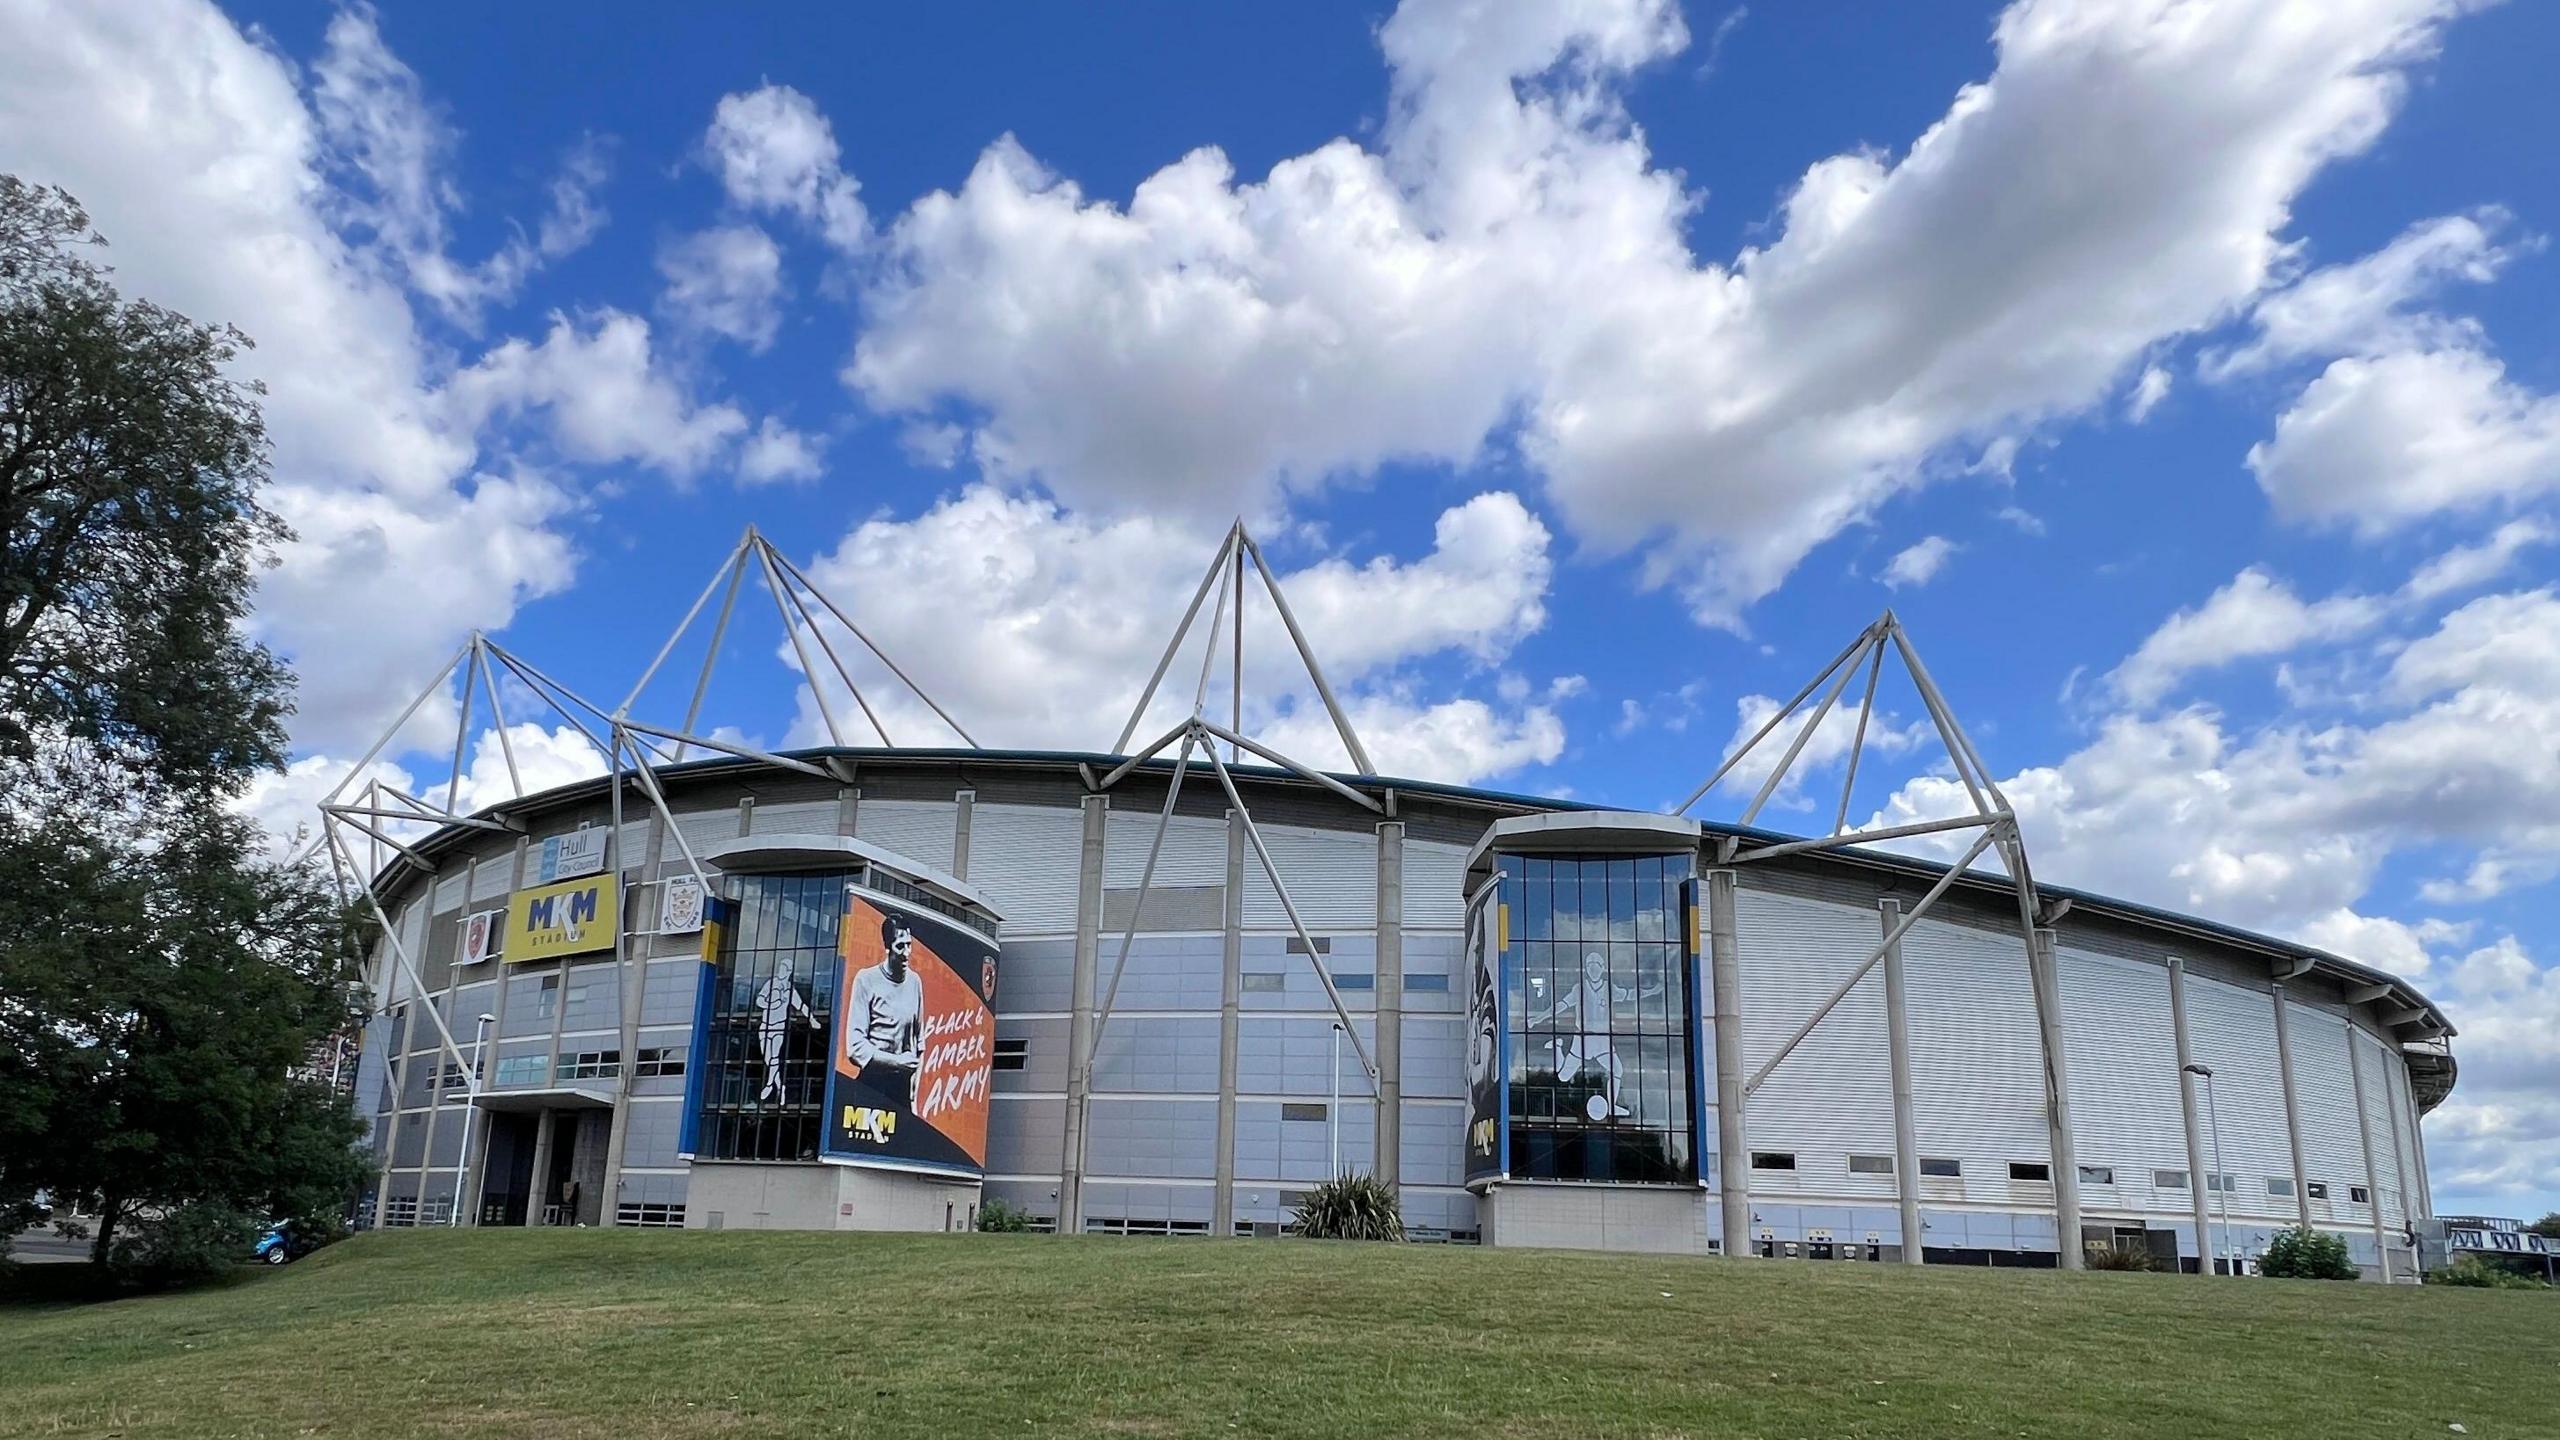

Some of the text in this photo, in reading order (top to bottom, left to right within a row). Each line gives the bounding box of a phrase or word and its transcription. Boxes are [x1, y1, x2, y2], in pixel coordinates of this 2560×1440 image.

[560, 834, 588, 857] Hull
[527, 887, 598, 943] MKM
[532, 929, 586, 946] STADIUM
[923, 1005, 984, 1039] BLACK &
[924, 1033, 986, 1074] AMBER
[922, 1064, 991, 1119] ARMY
[843, 1105, 896, 1144] MKM
